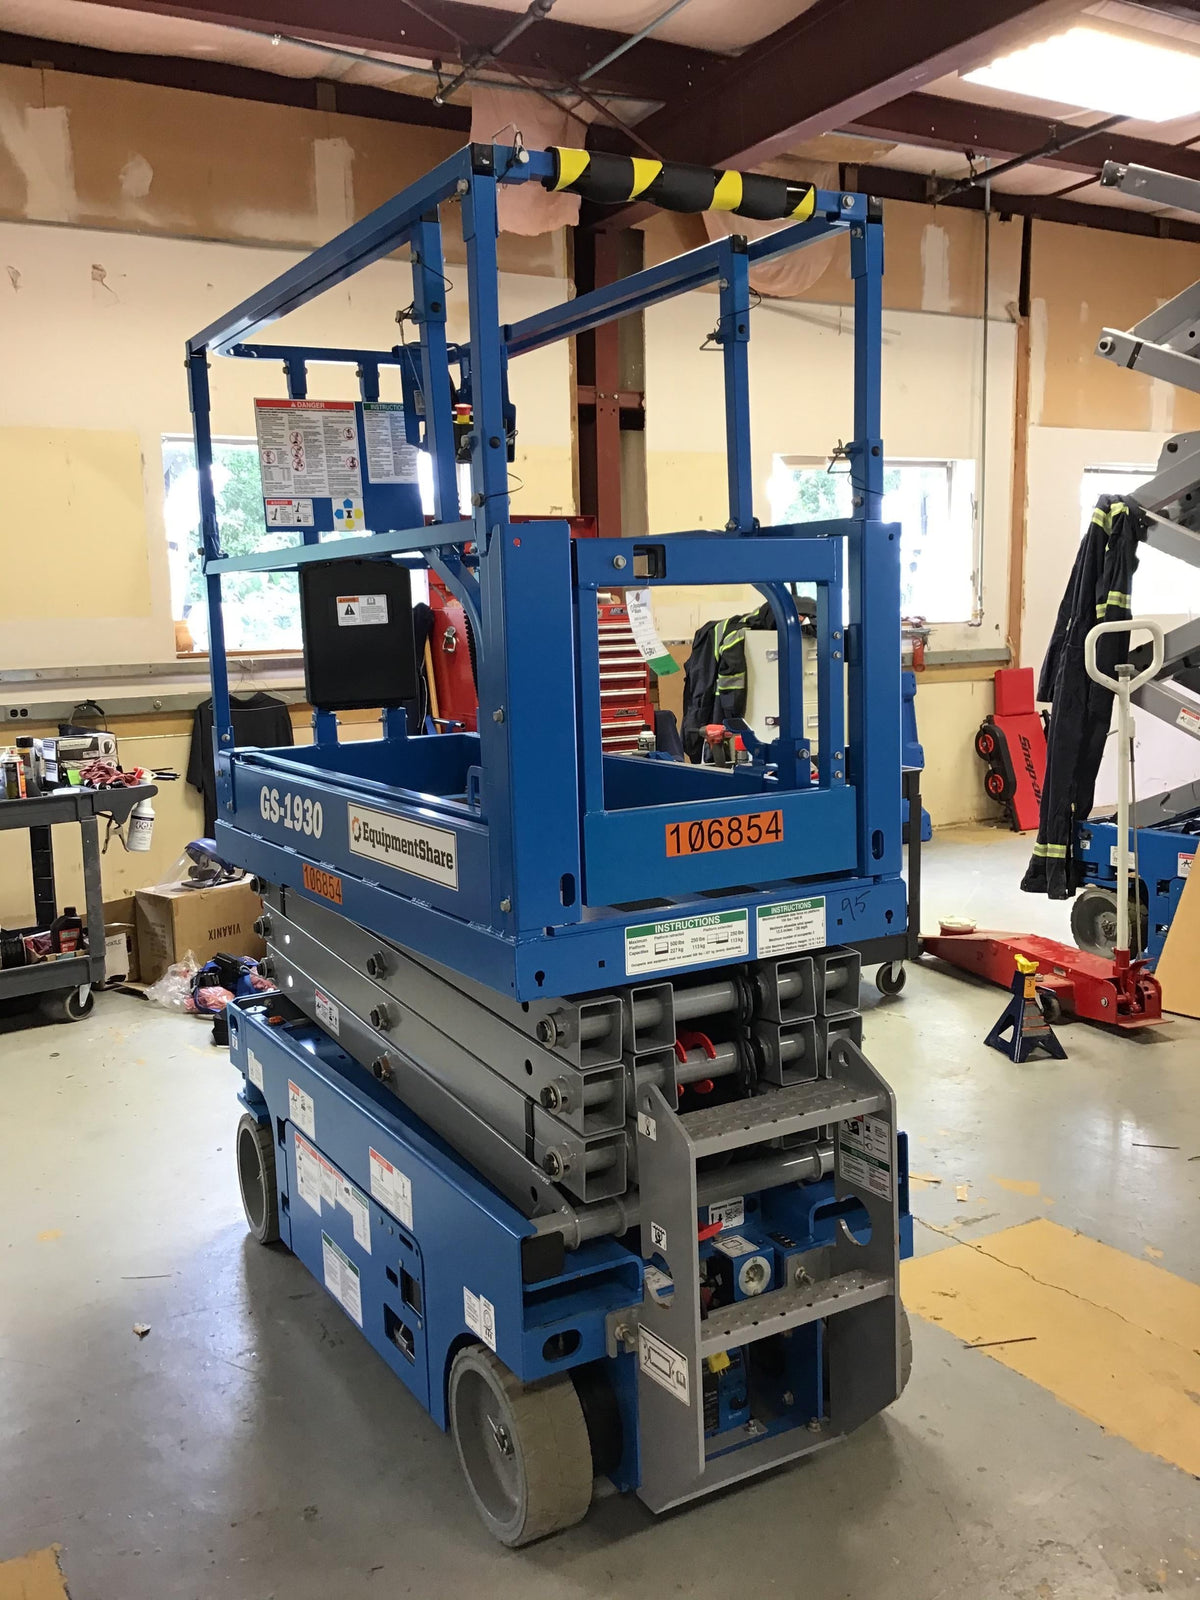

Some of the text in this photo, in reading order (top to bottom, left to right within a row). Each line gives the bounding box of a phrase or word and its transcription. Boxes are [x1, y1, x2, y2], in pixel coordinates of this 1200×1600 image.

[260, 785, 323, 839] GS-1930
[362, 821, 454, 870] EquipmentShare
[669, 811, 782, 854] 106854
[303, 864, 342, 903] 106854
[771, 901, 812, 913] INSTRUCTIONS
[842, 890, 871, 921] 95
[208, 923, 241, 941] VIAANIX
[654, 915, 720, 933] INSTRUCTIONS
